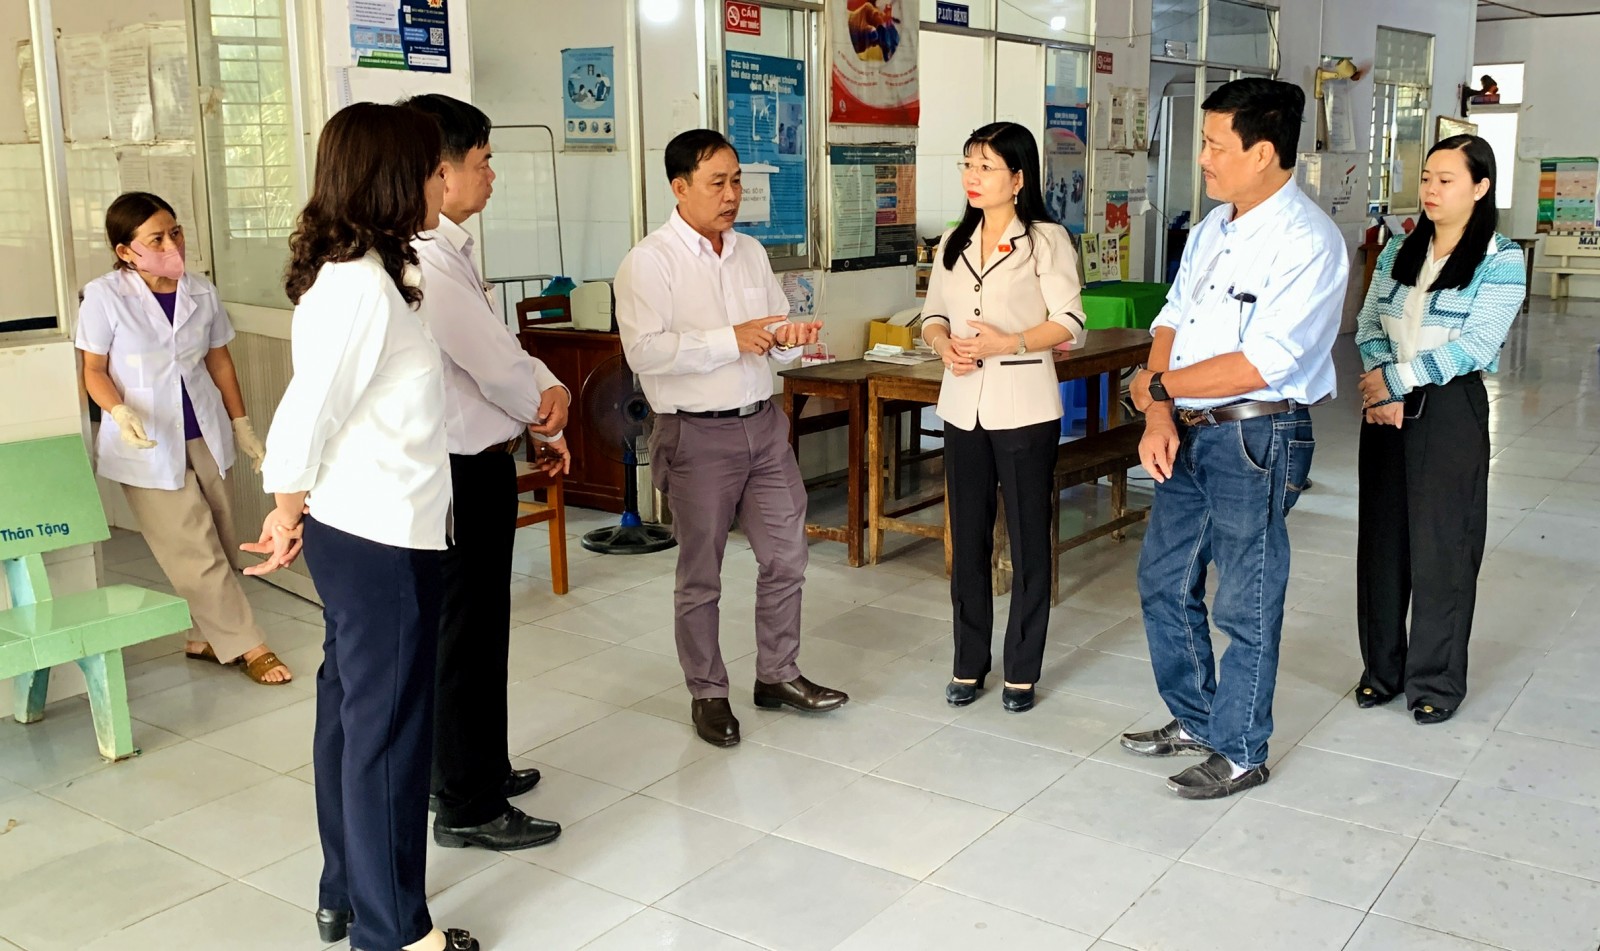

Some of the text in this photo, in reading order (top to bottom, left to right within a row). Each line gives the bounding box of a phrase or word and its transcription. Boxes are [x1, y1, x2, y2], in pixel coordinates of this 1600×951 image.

[741, 6, 758, 18] CẤM
[0, 522, 70, 541] Thân Tặng
